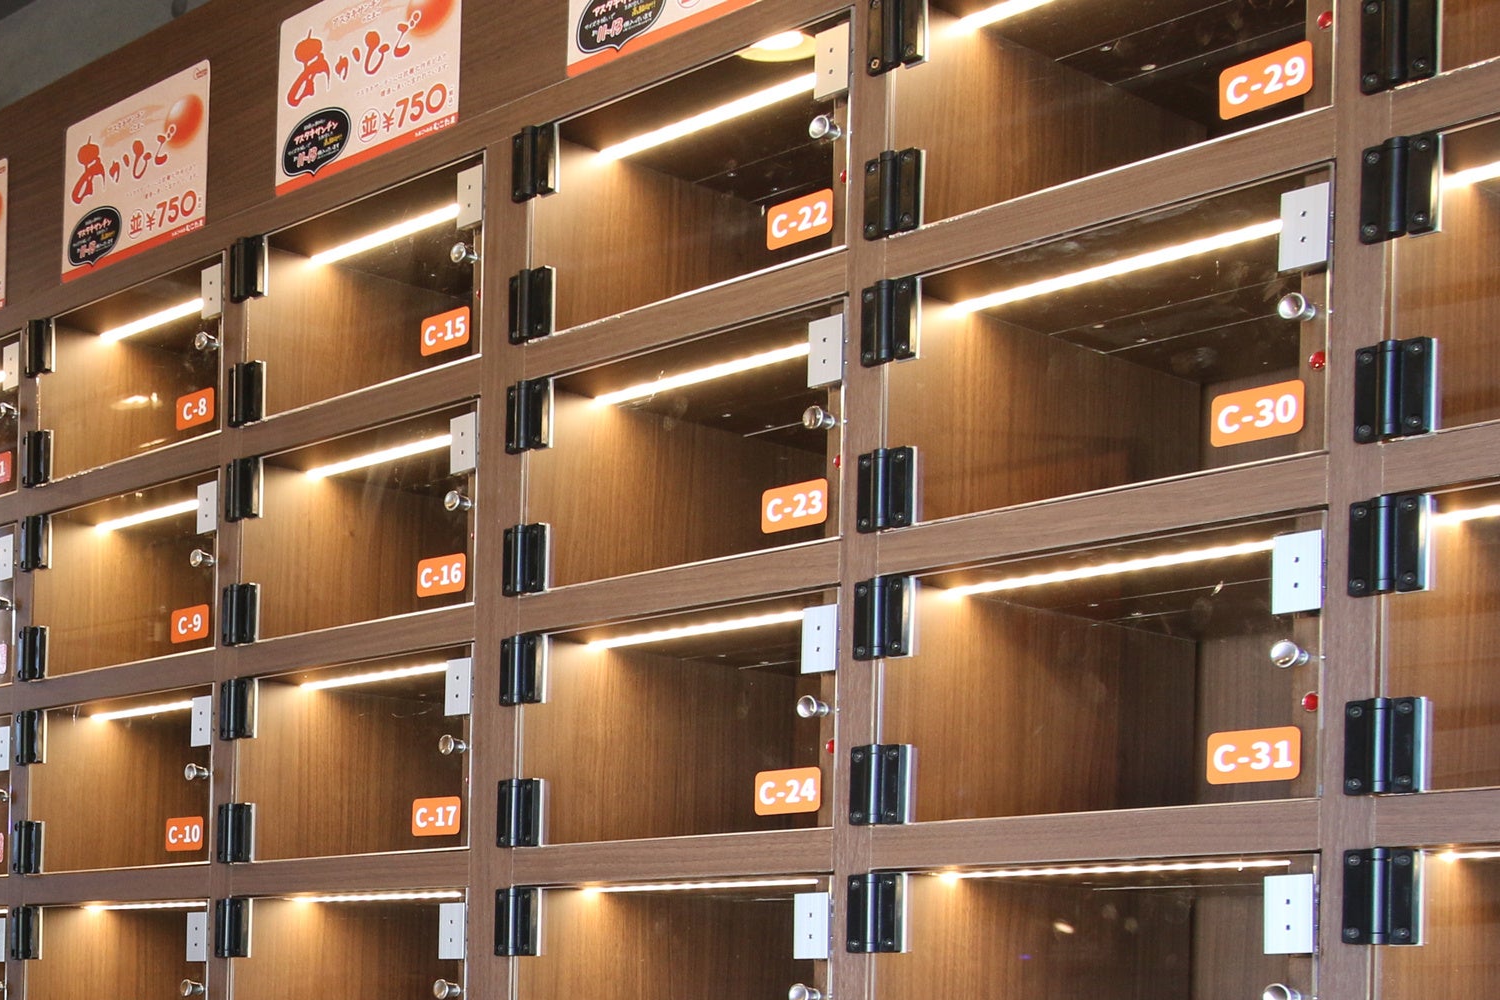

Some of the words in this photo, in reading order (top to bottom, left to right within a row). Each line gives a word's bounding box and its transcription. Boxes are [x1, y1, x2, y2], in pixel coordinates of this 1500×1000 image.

[287, 12, 420, 107] あかひご
[1226, 55, 1307, 105] C-29
[361, 112, 379, 139] 並
[71, 124, 177, 204] あかひご
[771, 200, 828, 239] C-22
[424, 315, 466, 346] C-15
[182, 397, 207, 421] C-8
[1217, 393, 1299, 434] C-30
[766, 489, 823, 523] C-23
[420, 562, 462, 588] C-16
[177, 613, 202, 635] C-9
[1213, 740, 1295, 773] C-31
[759, 777, 817, 805] C-24
[415, 805, 457, 828] C-17
[168, 824, 201, 844] C-10
